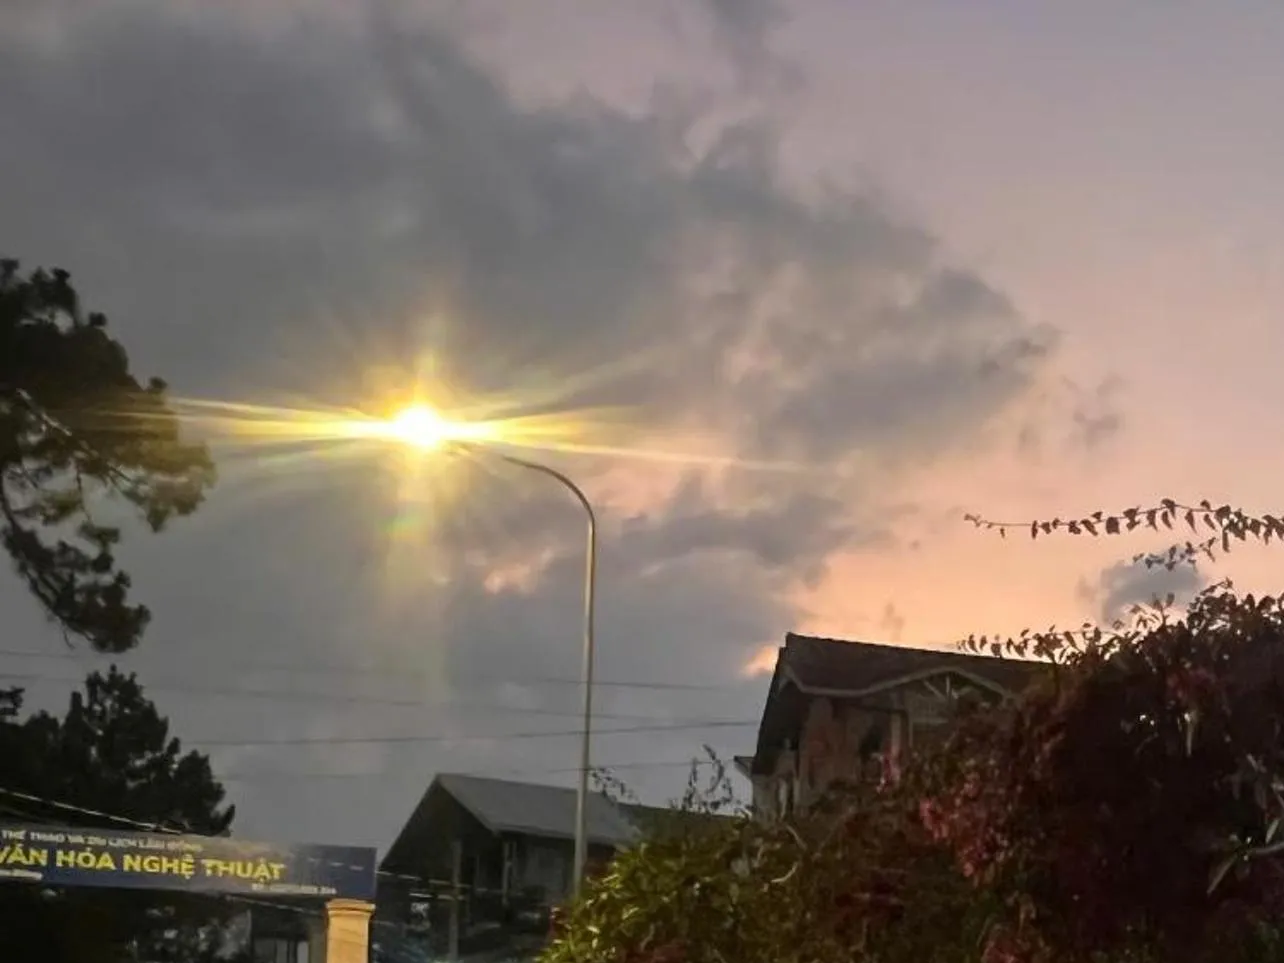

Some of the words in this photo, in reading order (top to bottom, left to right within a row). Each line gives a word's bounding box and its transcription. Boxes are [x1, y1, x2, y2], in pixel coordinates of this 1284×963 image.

[56, 847, 116, 871] HÓA
[123, 853, 195, 880] NGHỆ
[201, 857, 286, 882] THUẬT
